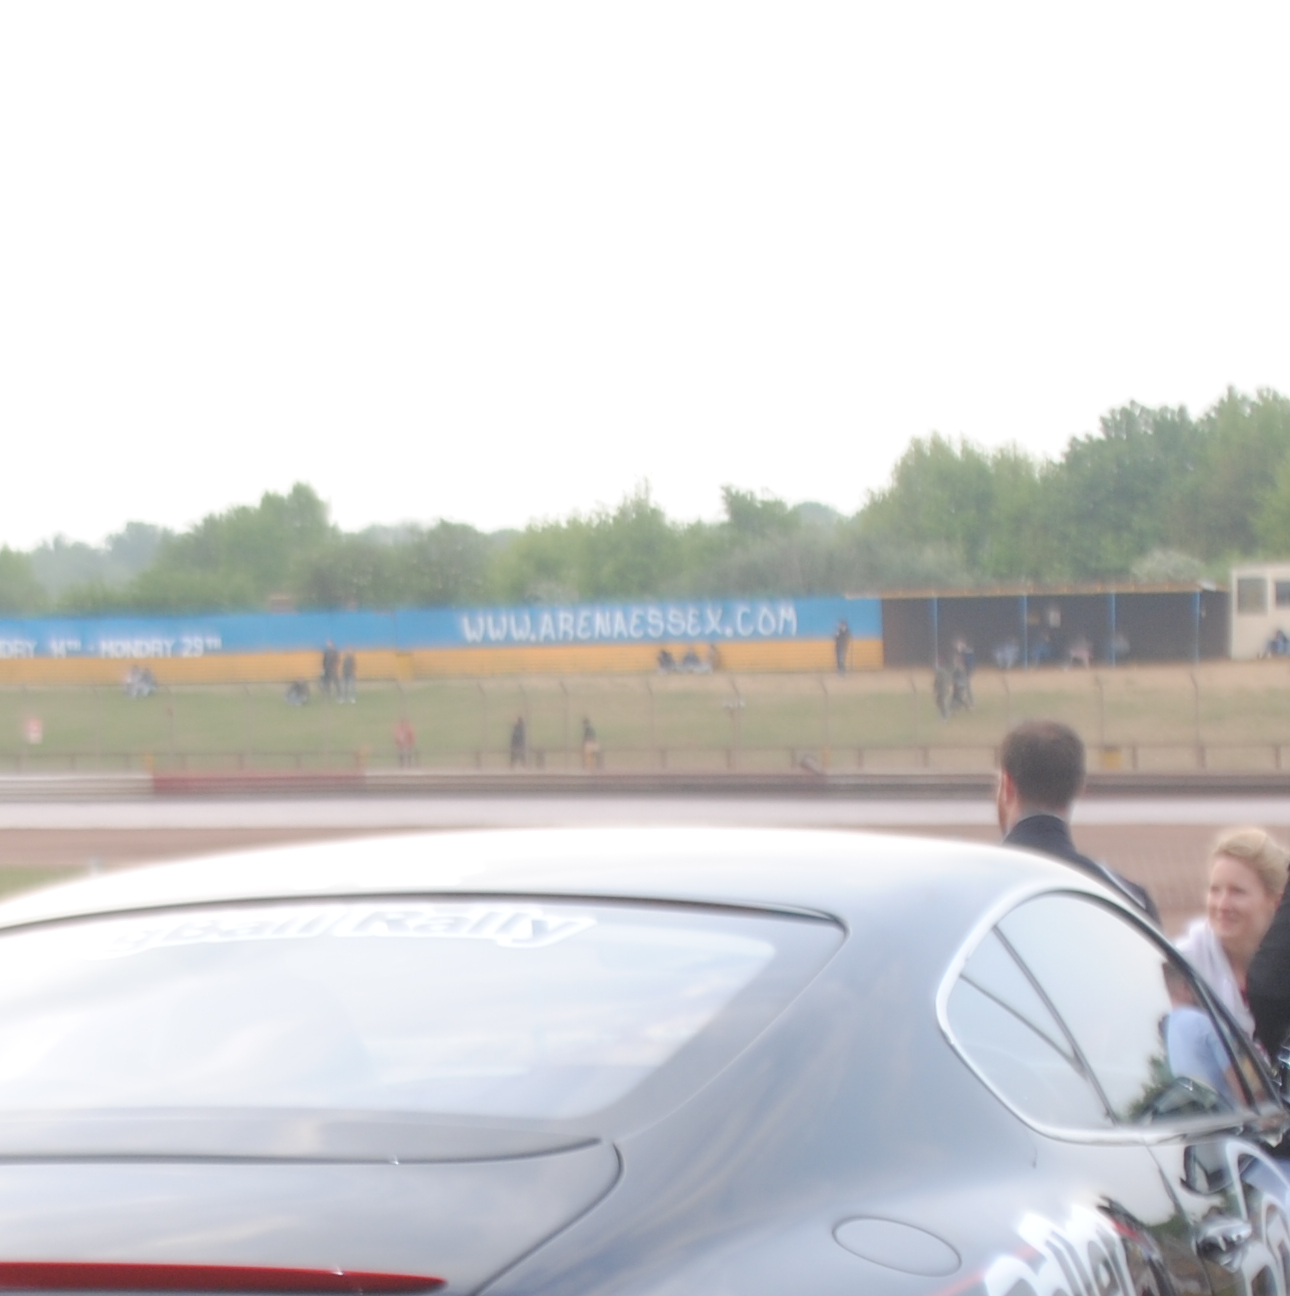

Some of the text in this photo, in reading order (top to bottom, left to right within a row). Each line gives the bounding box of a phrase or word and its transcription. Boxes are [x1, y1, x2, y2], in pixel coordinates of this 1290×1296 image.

[462, 603, 798, 643] WWW.ARENAESSEX.COM
[100, 637, 176, 660] MONDAY
[338, 903, 591, 948] Rally
